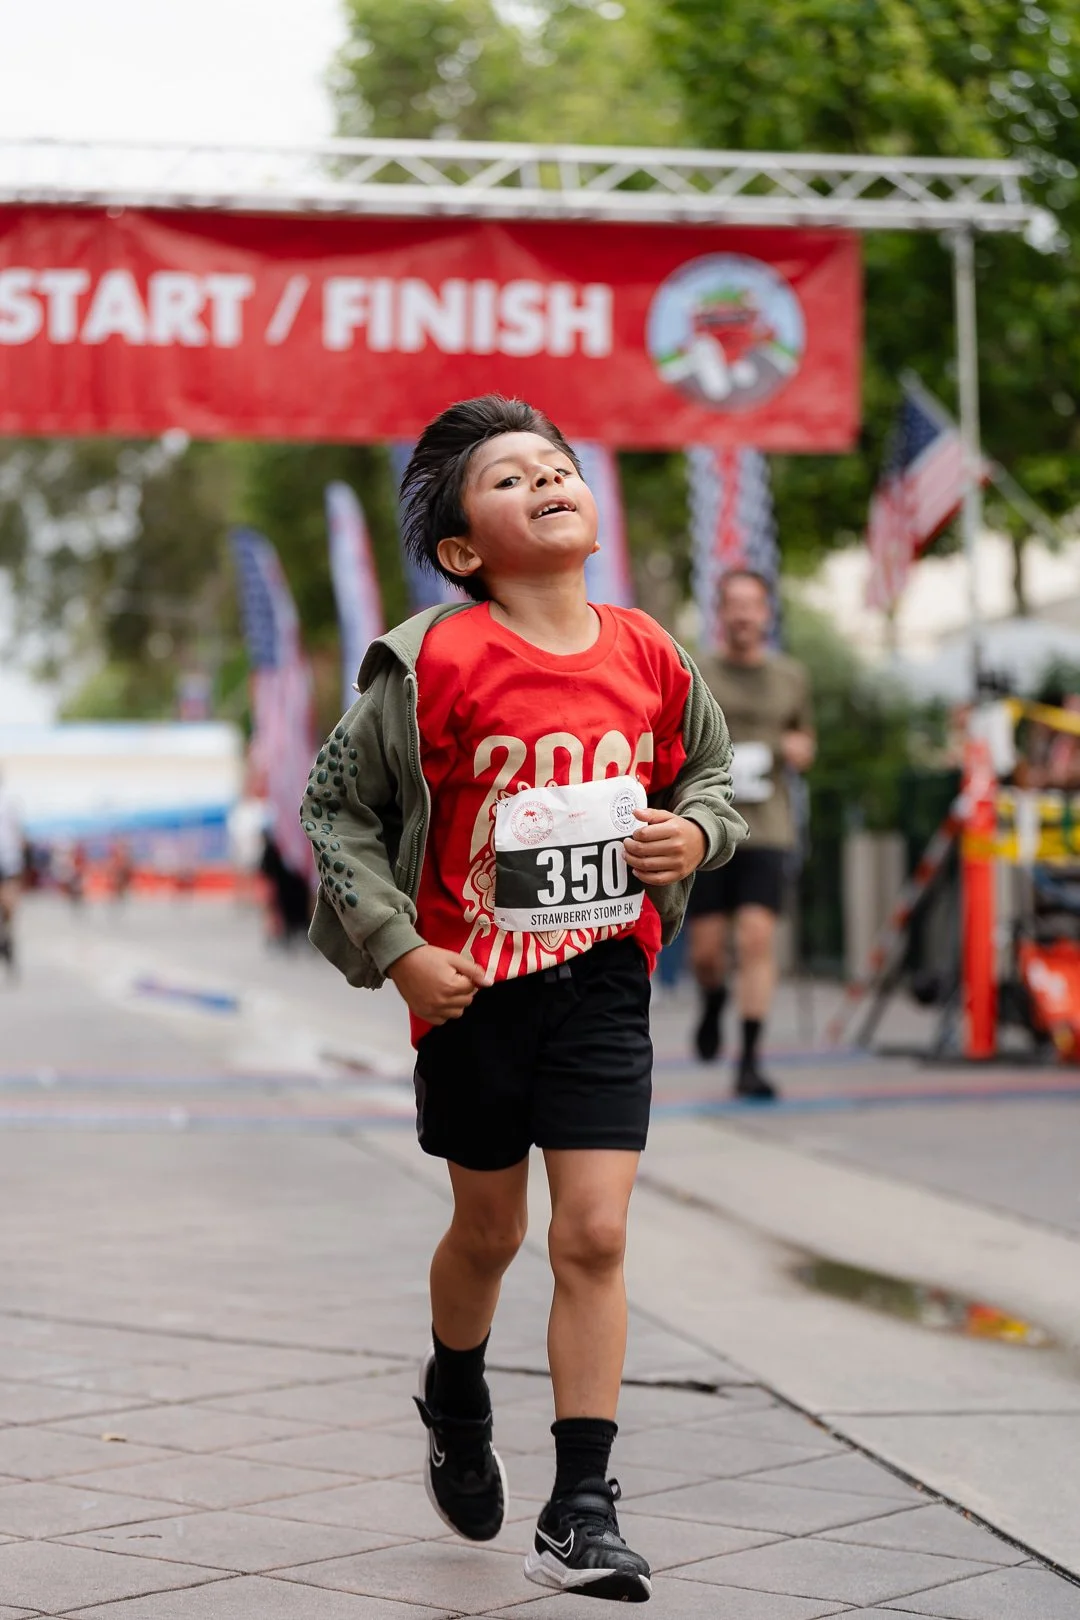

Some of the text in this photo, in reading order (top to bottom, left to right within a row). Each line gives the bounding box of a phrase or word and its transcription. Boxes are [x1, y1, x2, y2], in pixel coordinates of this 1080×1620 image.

[0, 268, 613, 358] START / FINISH
[536, 840, 628, 905] 350
[531, 902, 634, 926] STRAWBERRY STOMP 5K
